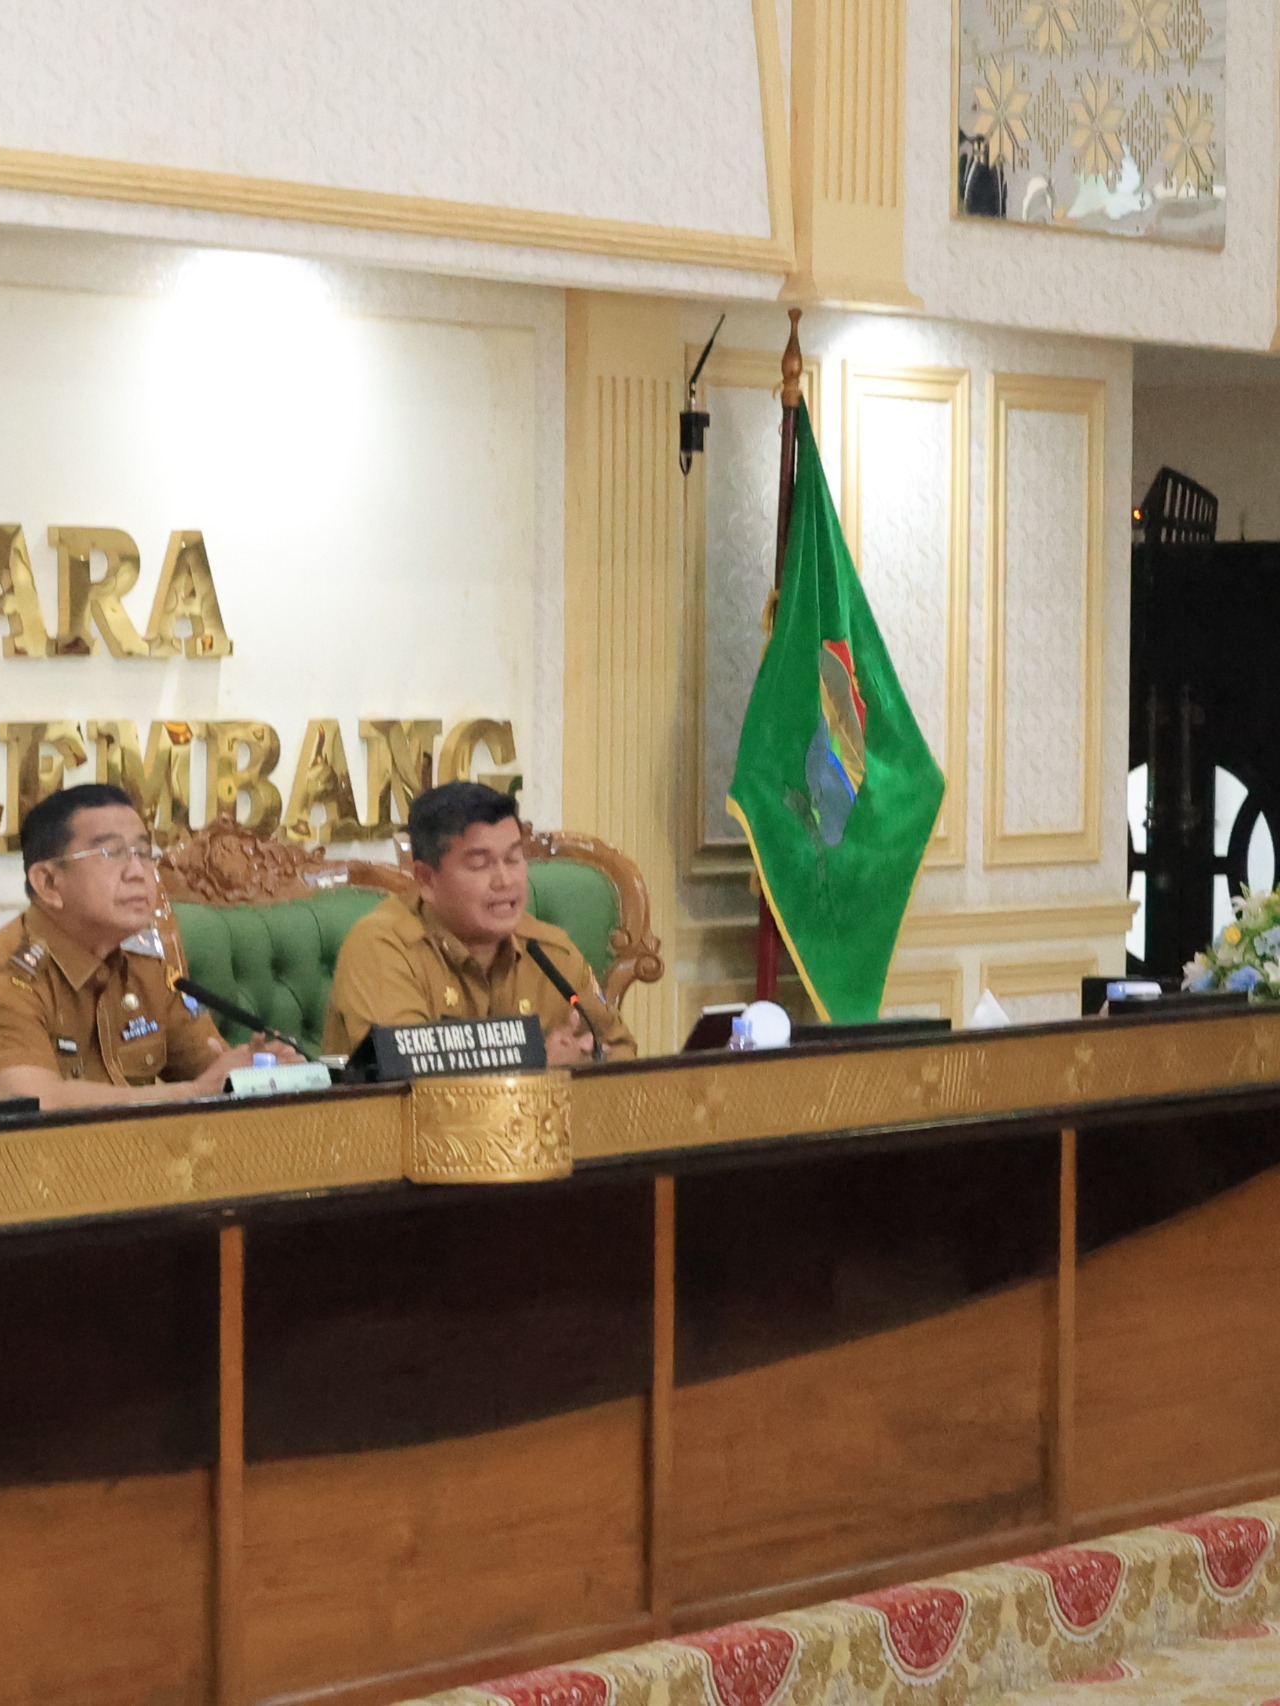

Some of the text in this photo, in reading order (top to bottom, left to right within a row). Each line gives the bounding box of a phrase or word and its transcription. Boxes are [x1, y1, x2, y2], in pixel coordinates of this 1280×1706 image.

[394, 1020, 526, 1055] SEKRETARIS DAERAH
[411, 1046, 522, 1074] KOTA PALEMBANG
